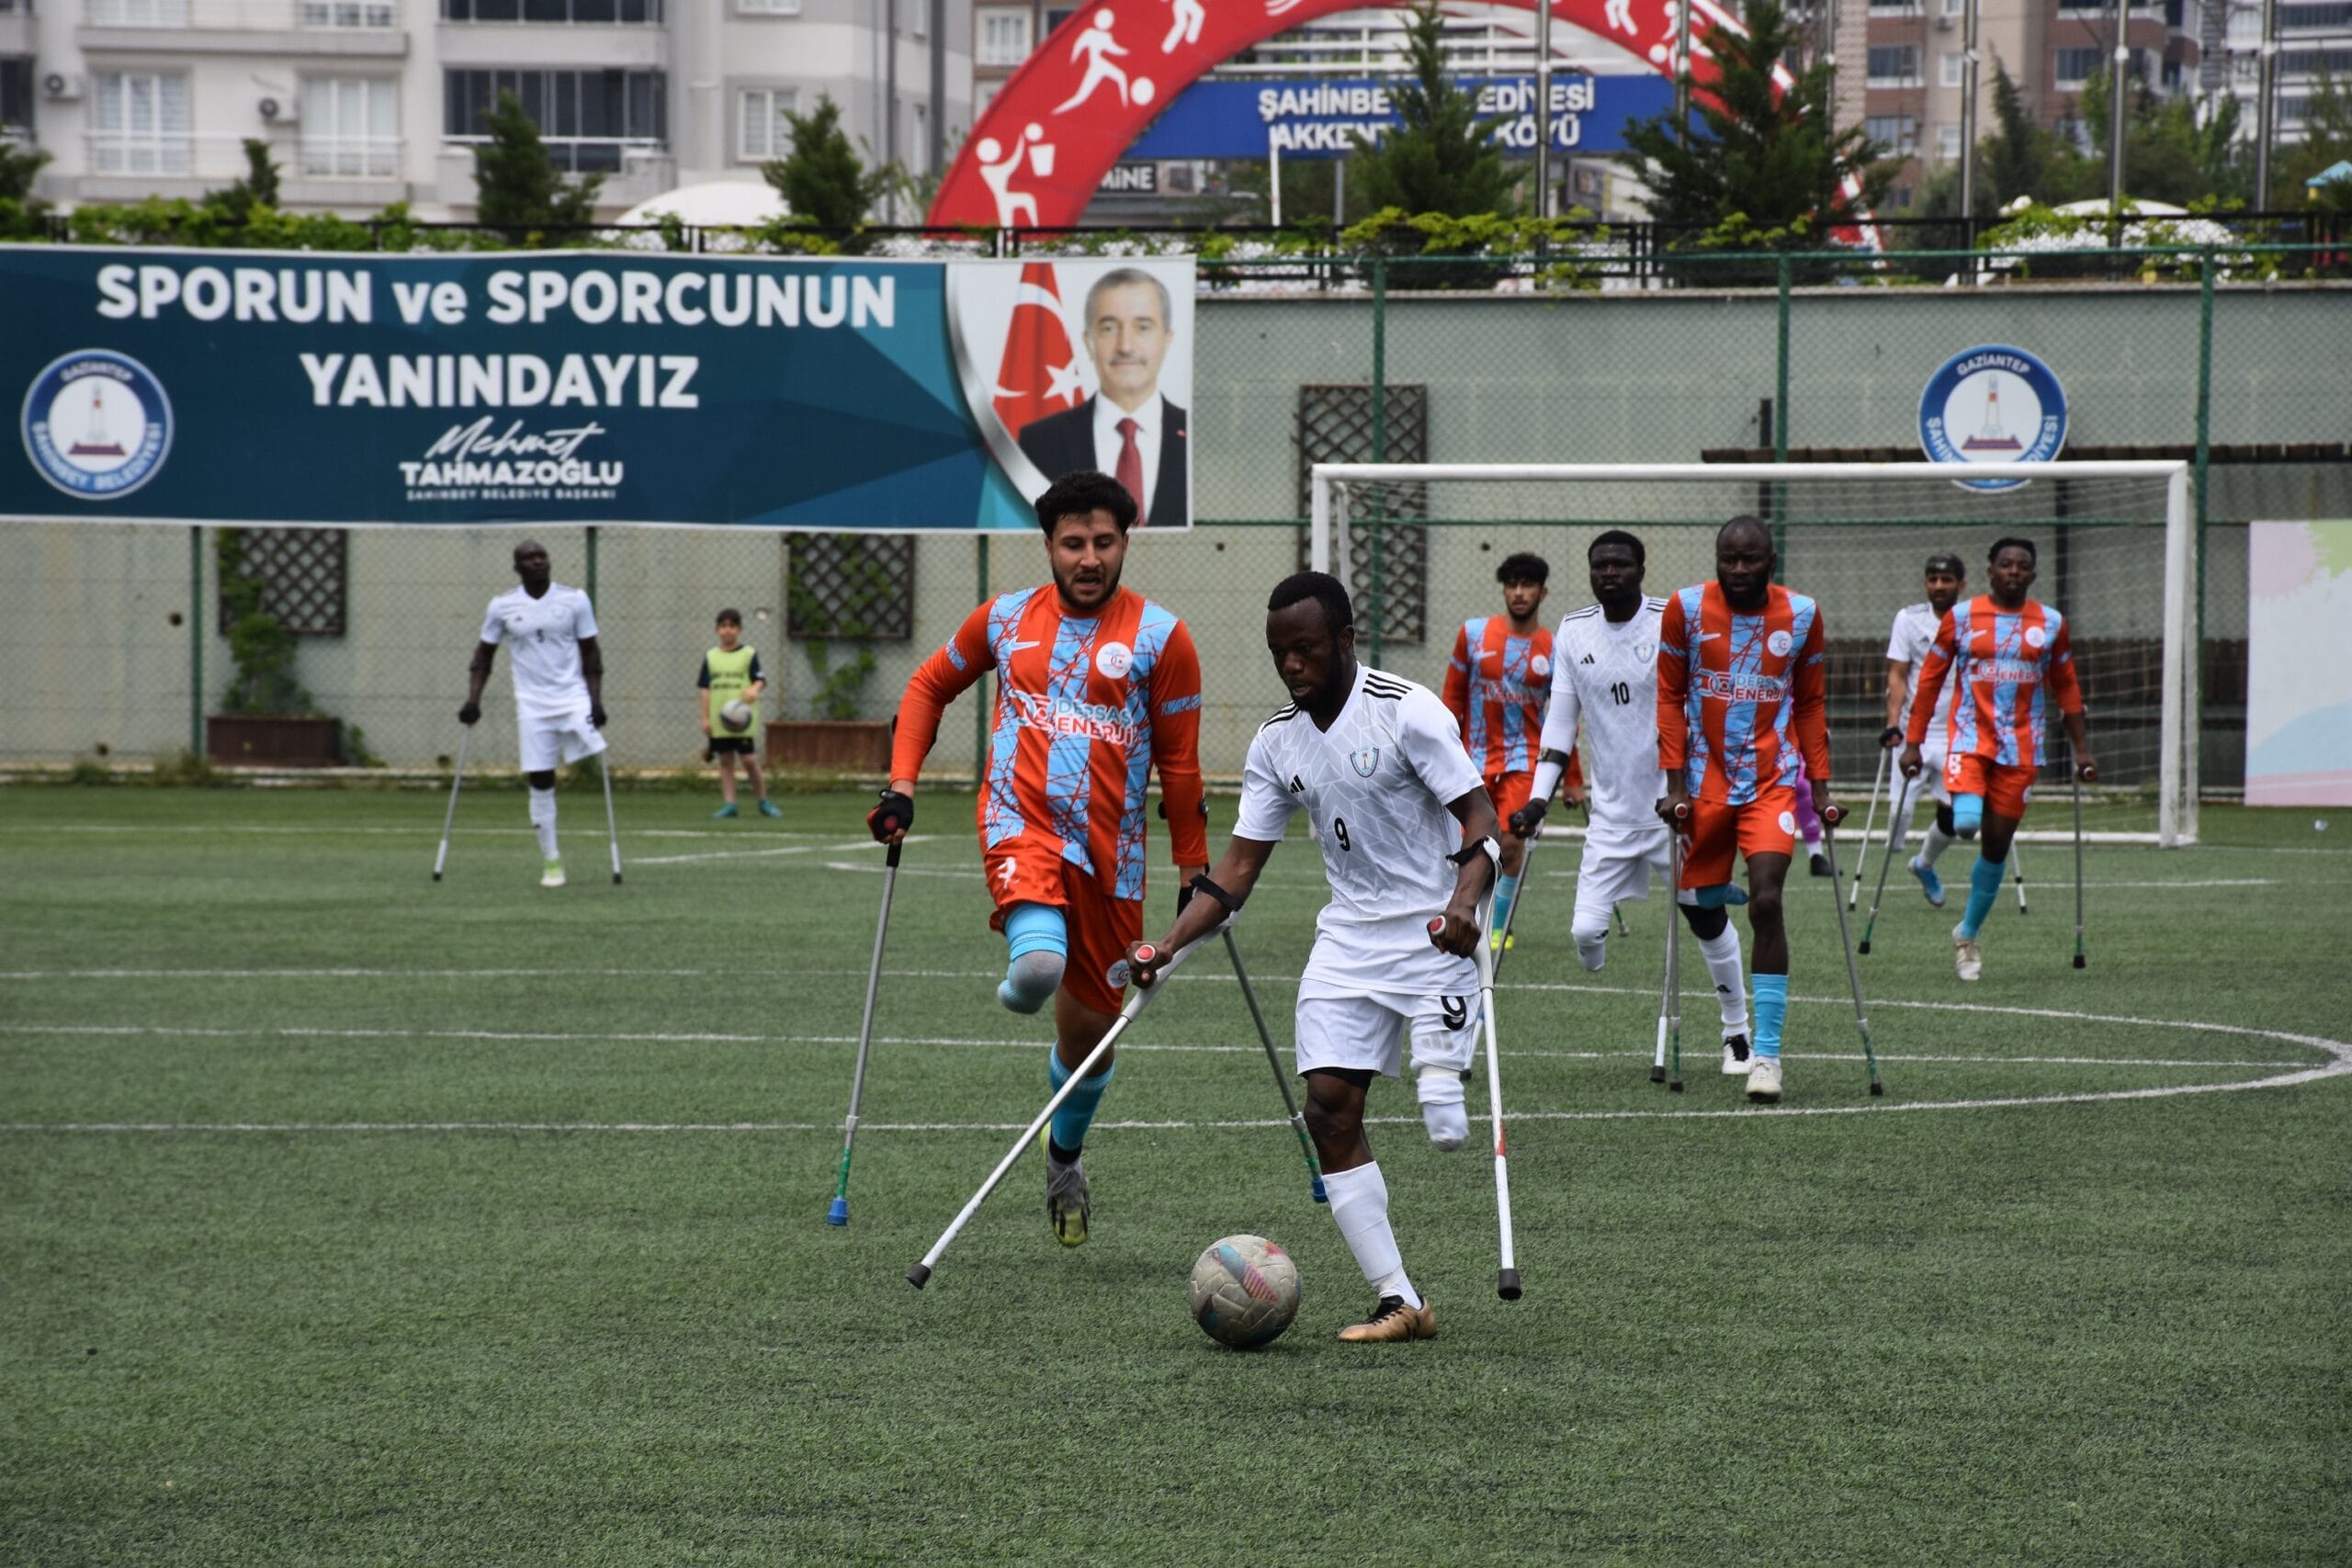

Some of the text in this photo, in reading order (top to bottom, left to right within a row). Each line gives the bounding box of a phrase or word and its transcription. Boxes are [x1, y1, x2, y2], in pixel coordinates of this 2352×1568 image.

[1258, 83, 1397, 121] ŞAHİNBE
[96, 265, 895, 328] SPORUN ve SPORCUNUN
[300, 353, 699, 409] YANINDAYIZ
[424, 415, 606, 463] Mehmet
[399, 457, 625, 487] TAHMAZOĞLU
[1611, 682, 1630, 705] 10
[1334, 817, 1351, 852] 9
[1441, 996, 1467, 1031] 9
